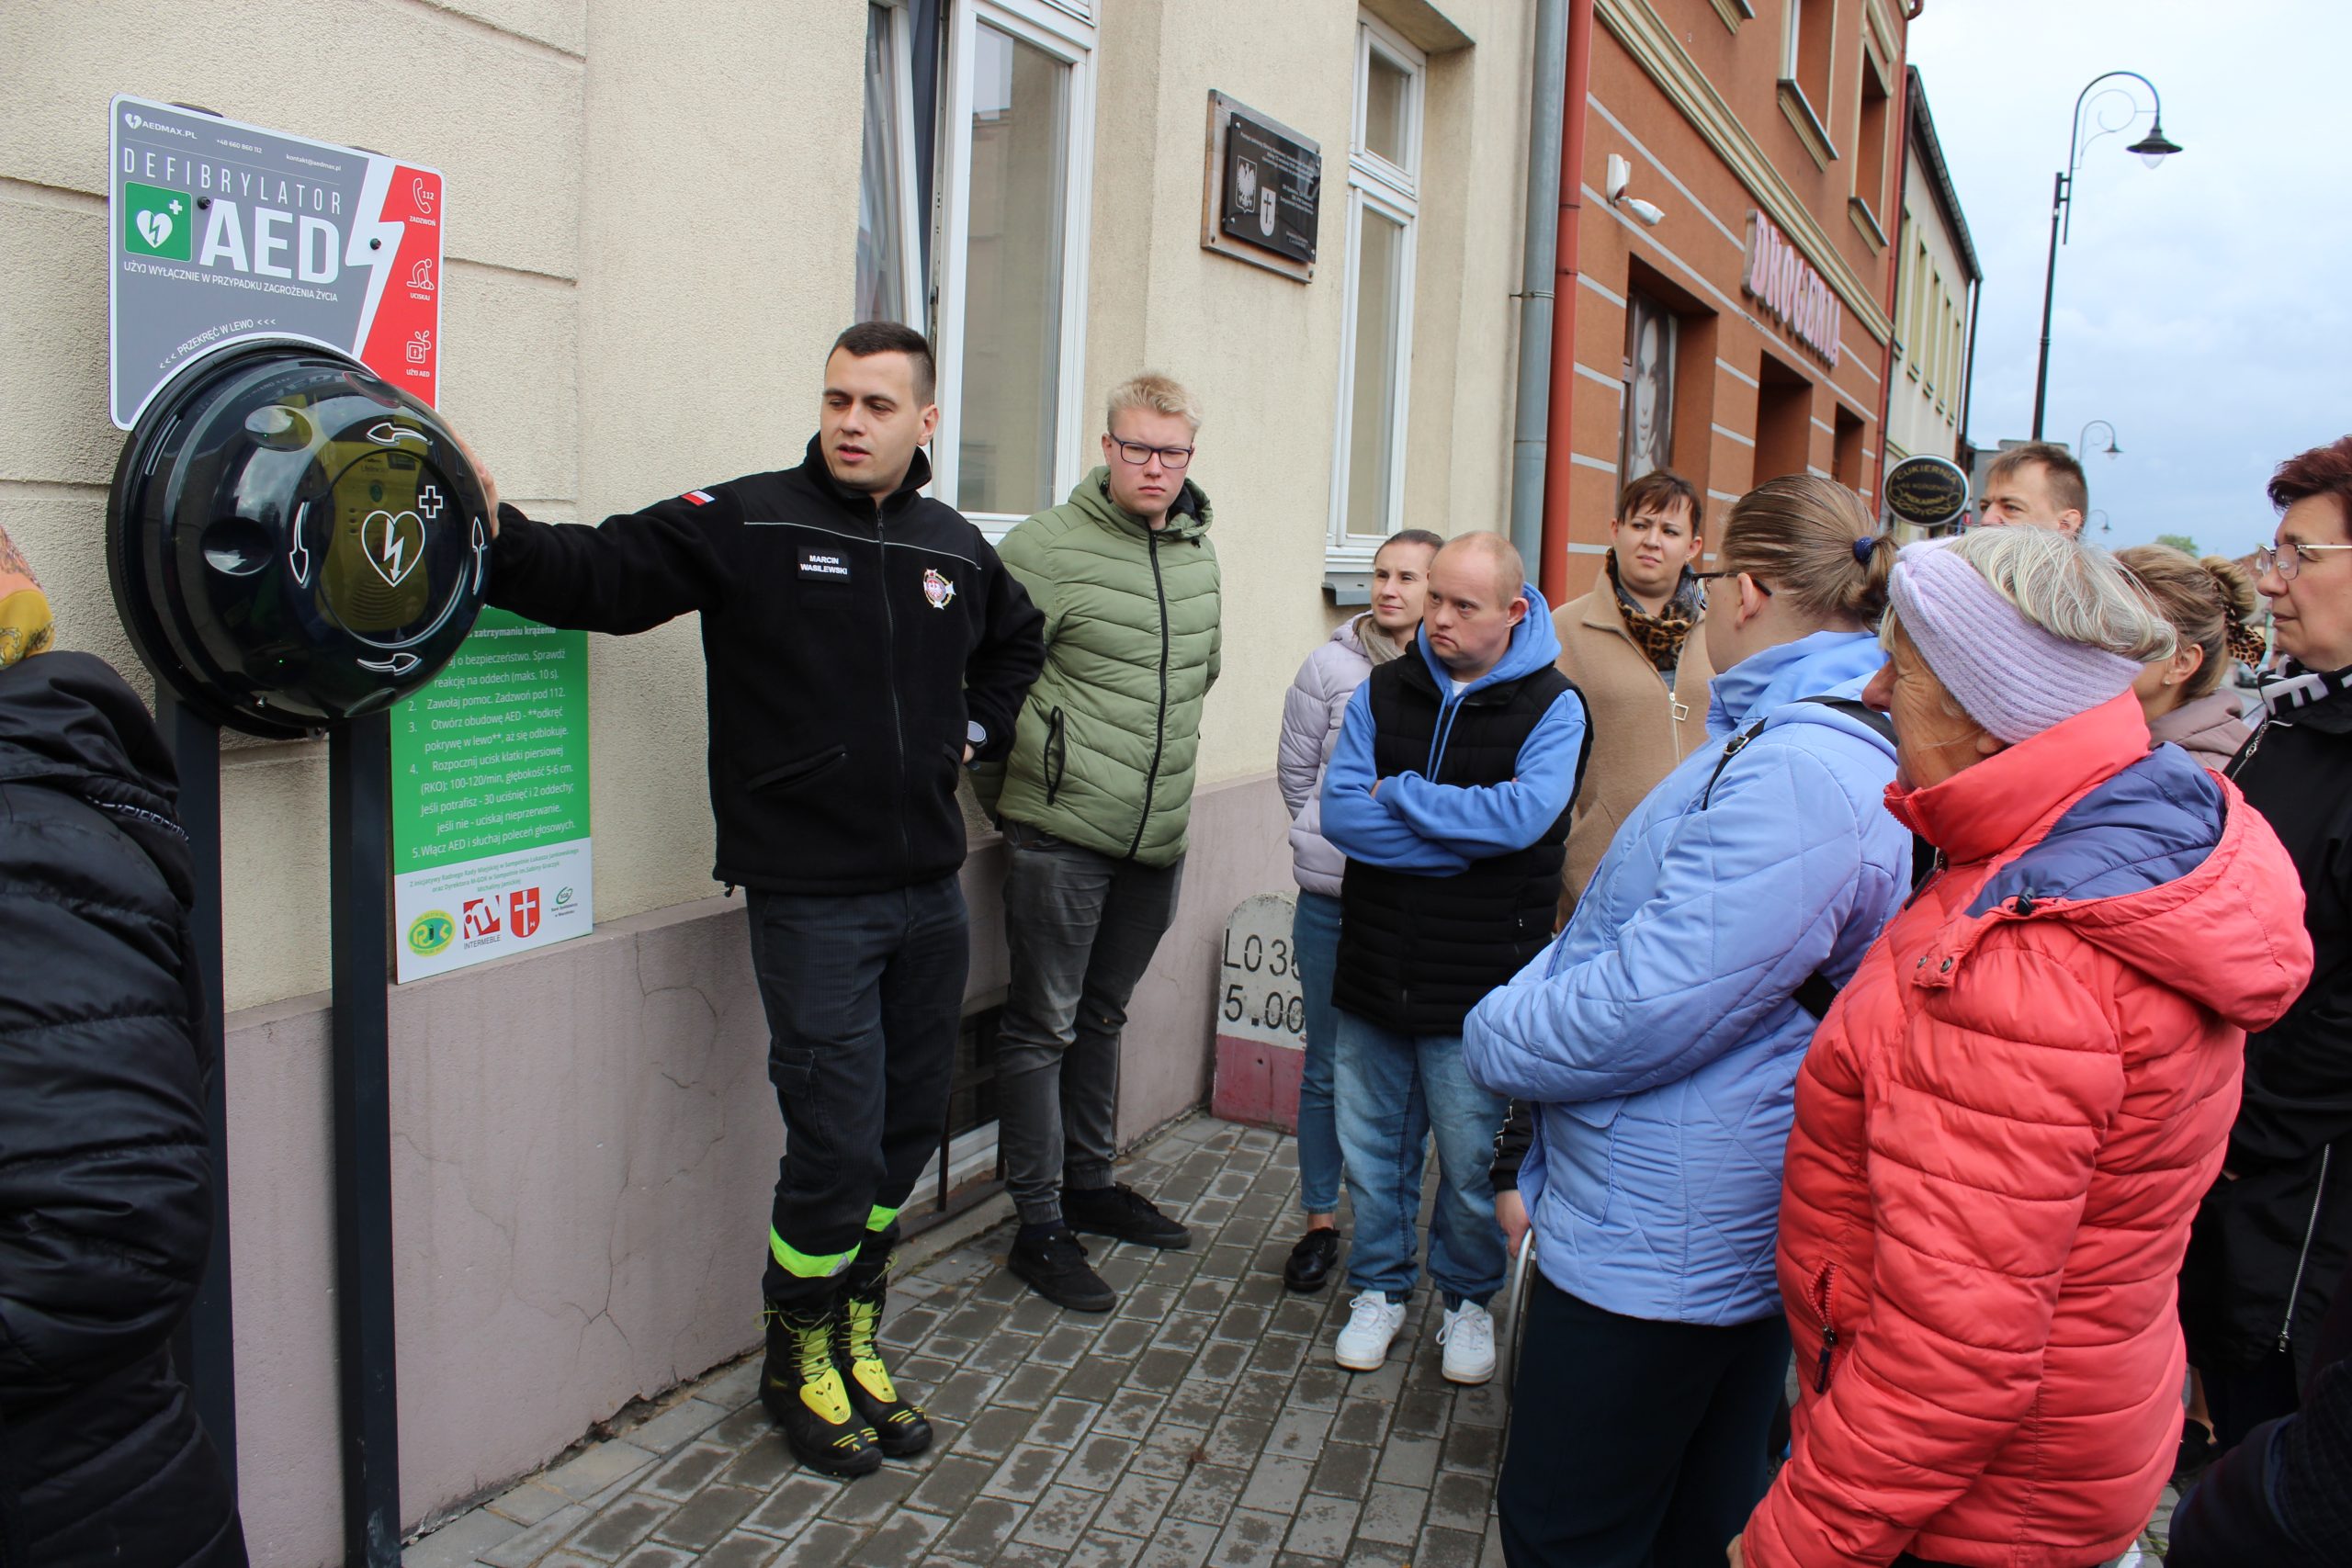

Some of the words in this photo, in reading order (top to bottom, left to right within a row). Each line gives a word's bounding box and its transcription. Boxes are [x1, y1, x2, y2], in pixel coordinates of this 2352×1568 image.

[141, 119, 198, 139] AEDMAX.PL
[125, 148, 340, 215] DEFIBRYLATOR
[422, 190, 435, 200] 112
[409, 216, 436, 227] ZADZWOŃ
[199, 198, 339, 284] AED
[124, 262, 146, 273] UŻYJ
[149, 265, 200, 282] WYŁĄCZNIE
[202, 273, 211, 283] W
[212, 275, 262, 290] PRZYPADKU
[264, 283, 315, 299] ZAGROŻENIA
[316, 288, 338, 301] ŻYCIA
[1749, 209, 1840, 367] DROGERIA
[410, 292, 431, 301] UCISKAJ
[177, 326, 220, 355] PRZEKRĘĆ
[220, 324, 229, 334] W
[230, 319, 254, 332] LEWO
[1896, 464, 1956, 484] CUKIERNIA
[800, 563, 848, 574] WASILEWSKI
[808, 555, 839, 564] MARCIN
[474, 626, 523, 639] zatrzymaniu
[533, 649, 565, 662] Sprawdź
[434, 676, 465, 689] reakcję
[467, 677, 478, 685] na
[480, 672, 510, 684] oddech
[539, 670, 549, 679] 10
[409, 701, 417, 711] 2.
[427, 697, 460, 709] Zawołaj
[462, 696, 493, 709] pomoc.
[495, 691, 531, 703] Zadzwoń
[533, 689, 548, 702] pod
[550, 687, 566, 697] 112.
[409, 722, 417, 732] 3.
[432, 717, 463, 730] Otwórz
[465, 715, 503, 727] obudowę
[504, 711, 521, 721] AED
[425, 739, 462, 754] pokrywę
[464, 739, 471, 747] w
[506, 734, 514, 742] aż
[516, 731, 528, 741] się
[529, 727, 568, 739] odblokuje.
[410, 764, 418, 774] 4.
[433, 757, 478, 772] Rozpocznij
[480, 753, 501, 765] ucisk
[524, 747, 563, 761] piersiowej
[421, 781, 447, 795] (RKO):
[506, 766, 545, 784] głębokość
[547, 764, 559, 775] 5-6
[560, 764, 573, 773] cm.
[440, 797, 477, 814] potrafisz
[484, 794, 495, 805] 30
[496, 788, 527, 803] uciśnięć
[529, 787, 532, 797] i
[533, 787, 539, 796] 2
[437, 820, 454, 836] jeśli
[456, 818, 469, 829] nie
[476, 814, 503, 826] uciskaj
[413, 848, 422, 858] 5.
[421, 844, 447, 856] Włącz
[448, 839, 466, 851] AED
[468, 838, 470, 848] i
[472, 834, 501, 847] słuchaj
[503, 827, 534, 843] poleceń
[535, 819, 575, 838] głosowych.
[463, 934, 501, 950] INTERMEBLE
